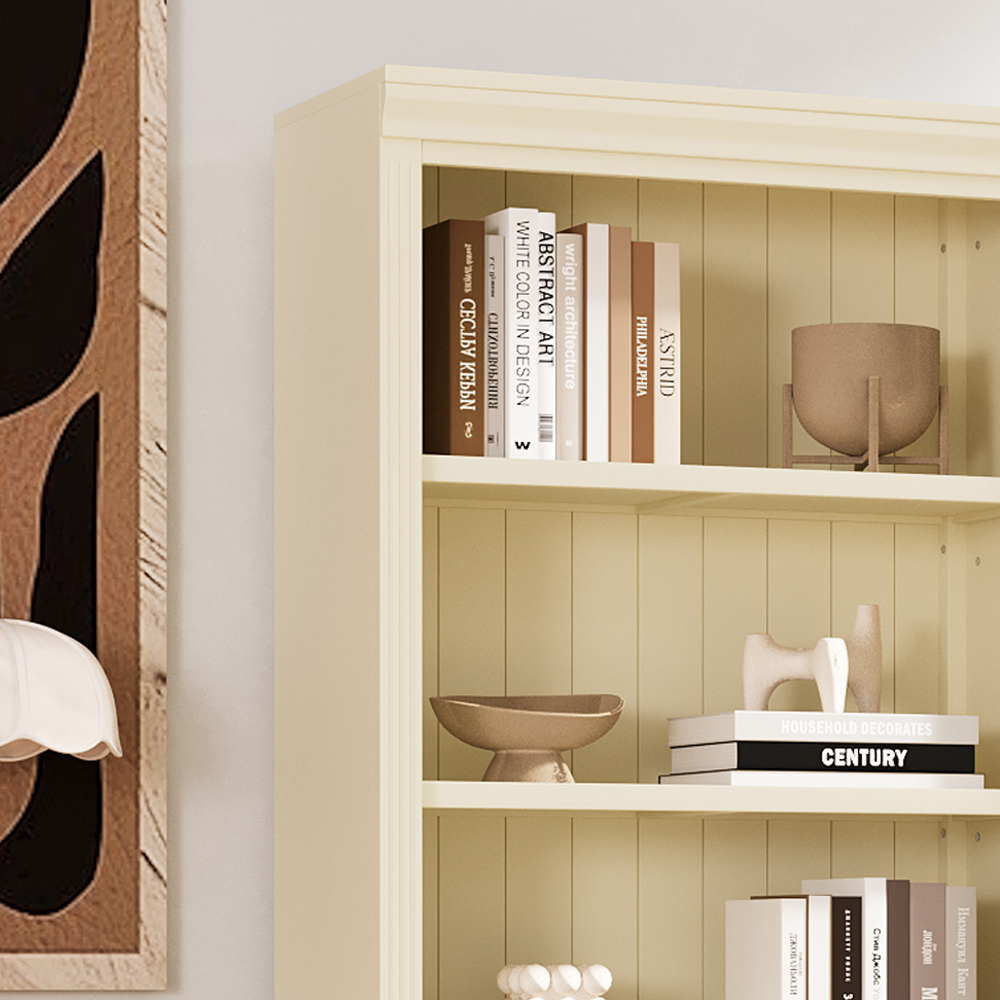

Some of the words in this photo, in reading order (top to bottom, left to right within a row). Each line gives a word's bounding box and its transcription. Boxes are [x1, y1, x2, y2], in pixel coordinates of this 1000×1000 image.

[516, 221, 530, 268] WHITE
[562, 243, 578, 292] wright
[516, 272, 530, 320] COLOR
[538, 231, 554, 326] ABSTRACT
[516, 325, 530, 339] IN
[539, 331, 554, 366] ART
[565, 296, 578, 390] architecture
[516, 345, 530, 406] DESIGN
[636, 316, 648, 397] PHILADELPHIA
[781, 720, 858, 735] HOUSEHOLD
[860, 721, 932, 736] DECORATES
[822, 748, 908, 767] CENTURY
[956, 907, 970, 964] Иммануил
[958, 968, 970, 996] Кант
